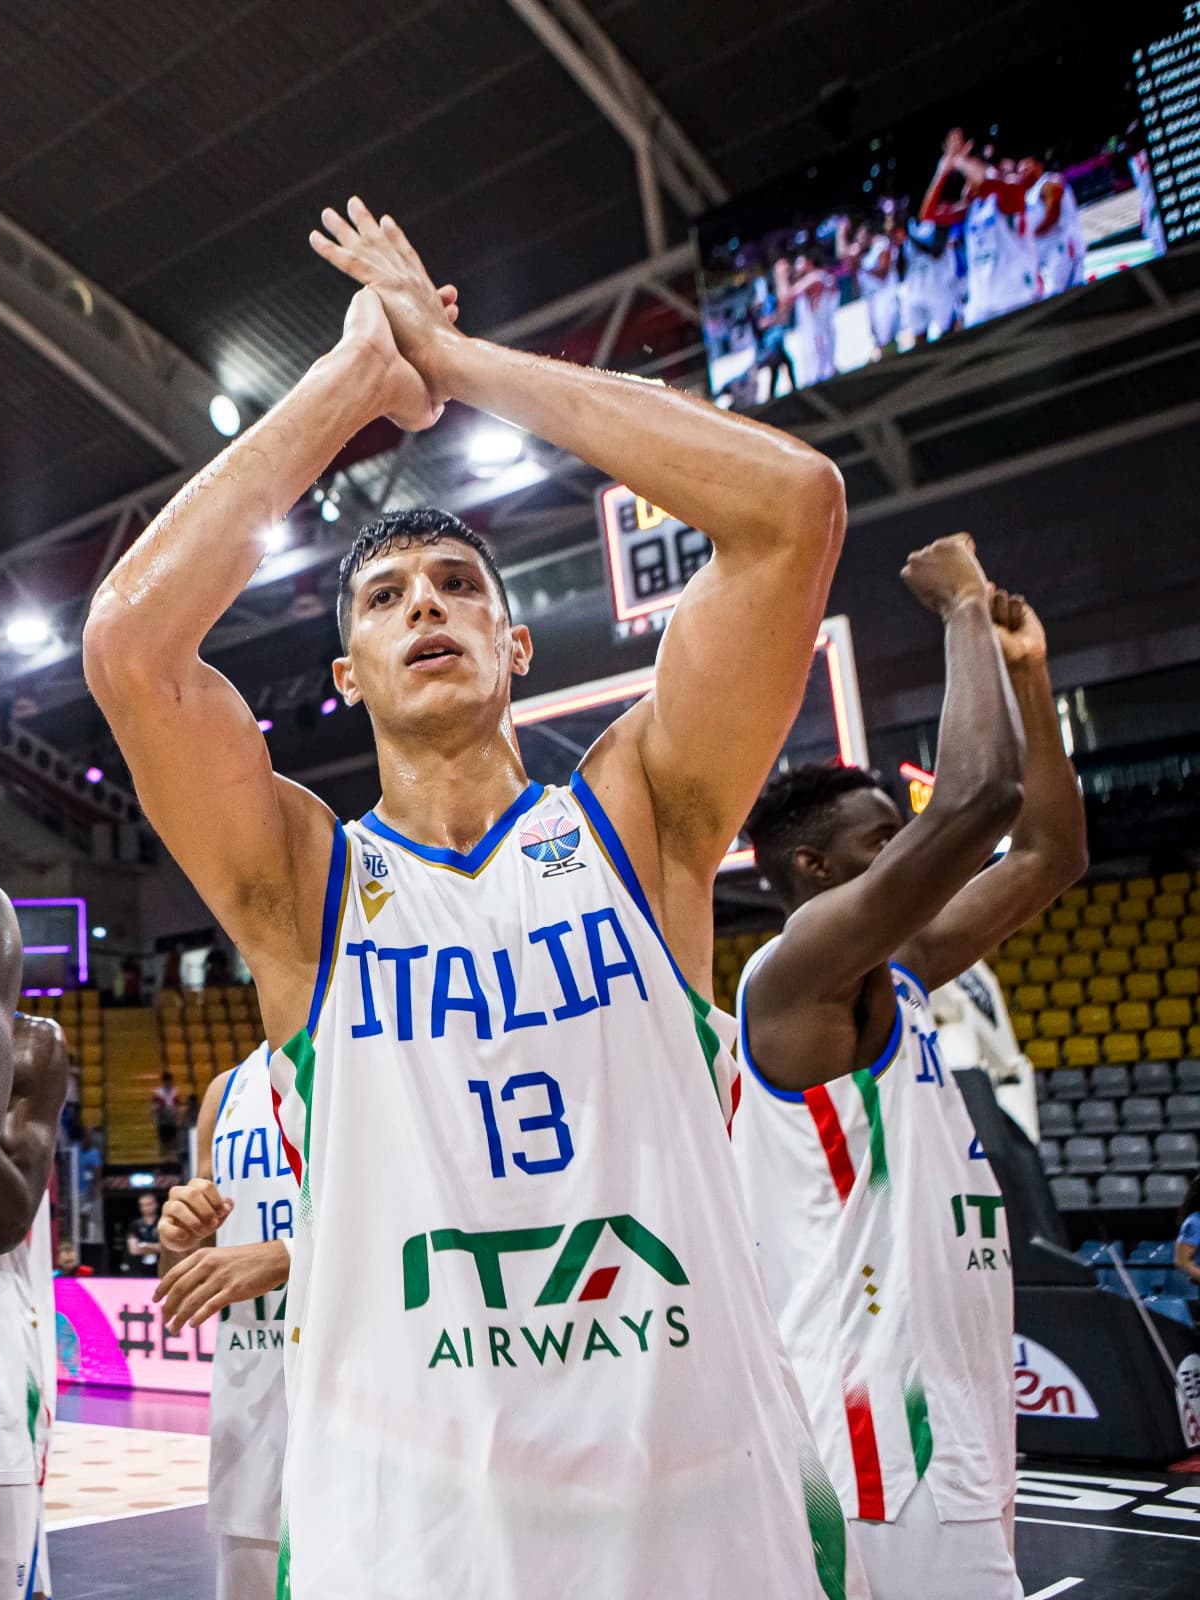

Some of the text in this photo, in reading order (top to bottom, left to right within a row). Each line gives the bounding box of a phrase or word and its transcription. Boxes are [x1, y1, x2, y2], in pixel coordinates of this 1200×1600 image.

[542, 857, 587, 878] 25
[346, 907, 648, 1041] ITALIA
[468, 1071, 574, 1178] 13
[215, 1127, 292, 1185] ITAL
[258, 1199, 294, 1242] 18
[951, 1194, 1004, 1239] IT
[402, 1214, 691, 1311] ITA
[230, 1329, 284, 1351] AIRW
[428, 1305, 691, 1369] AIRWAYS
